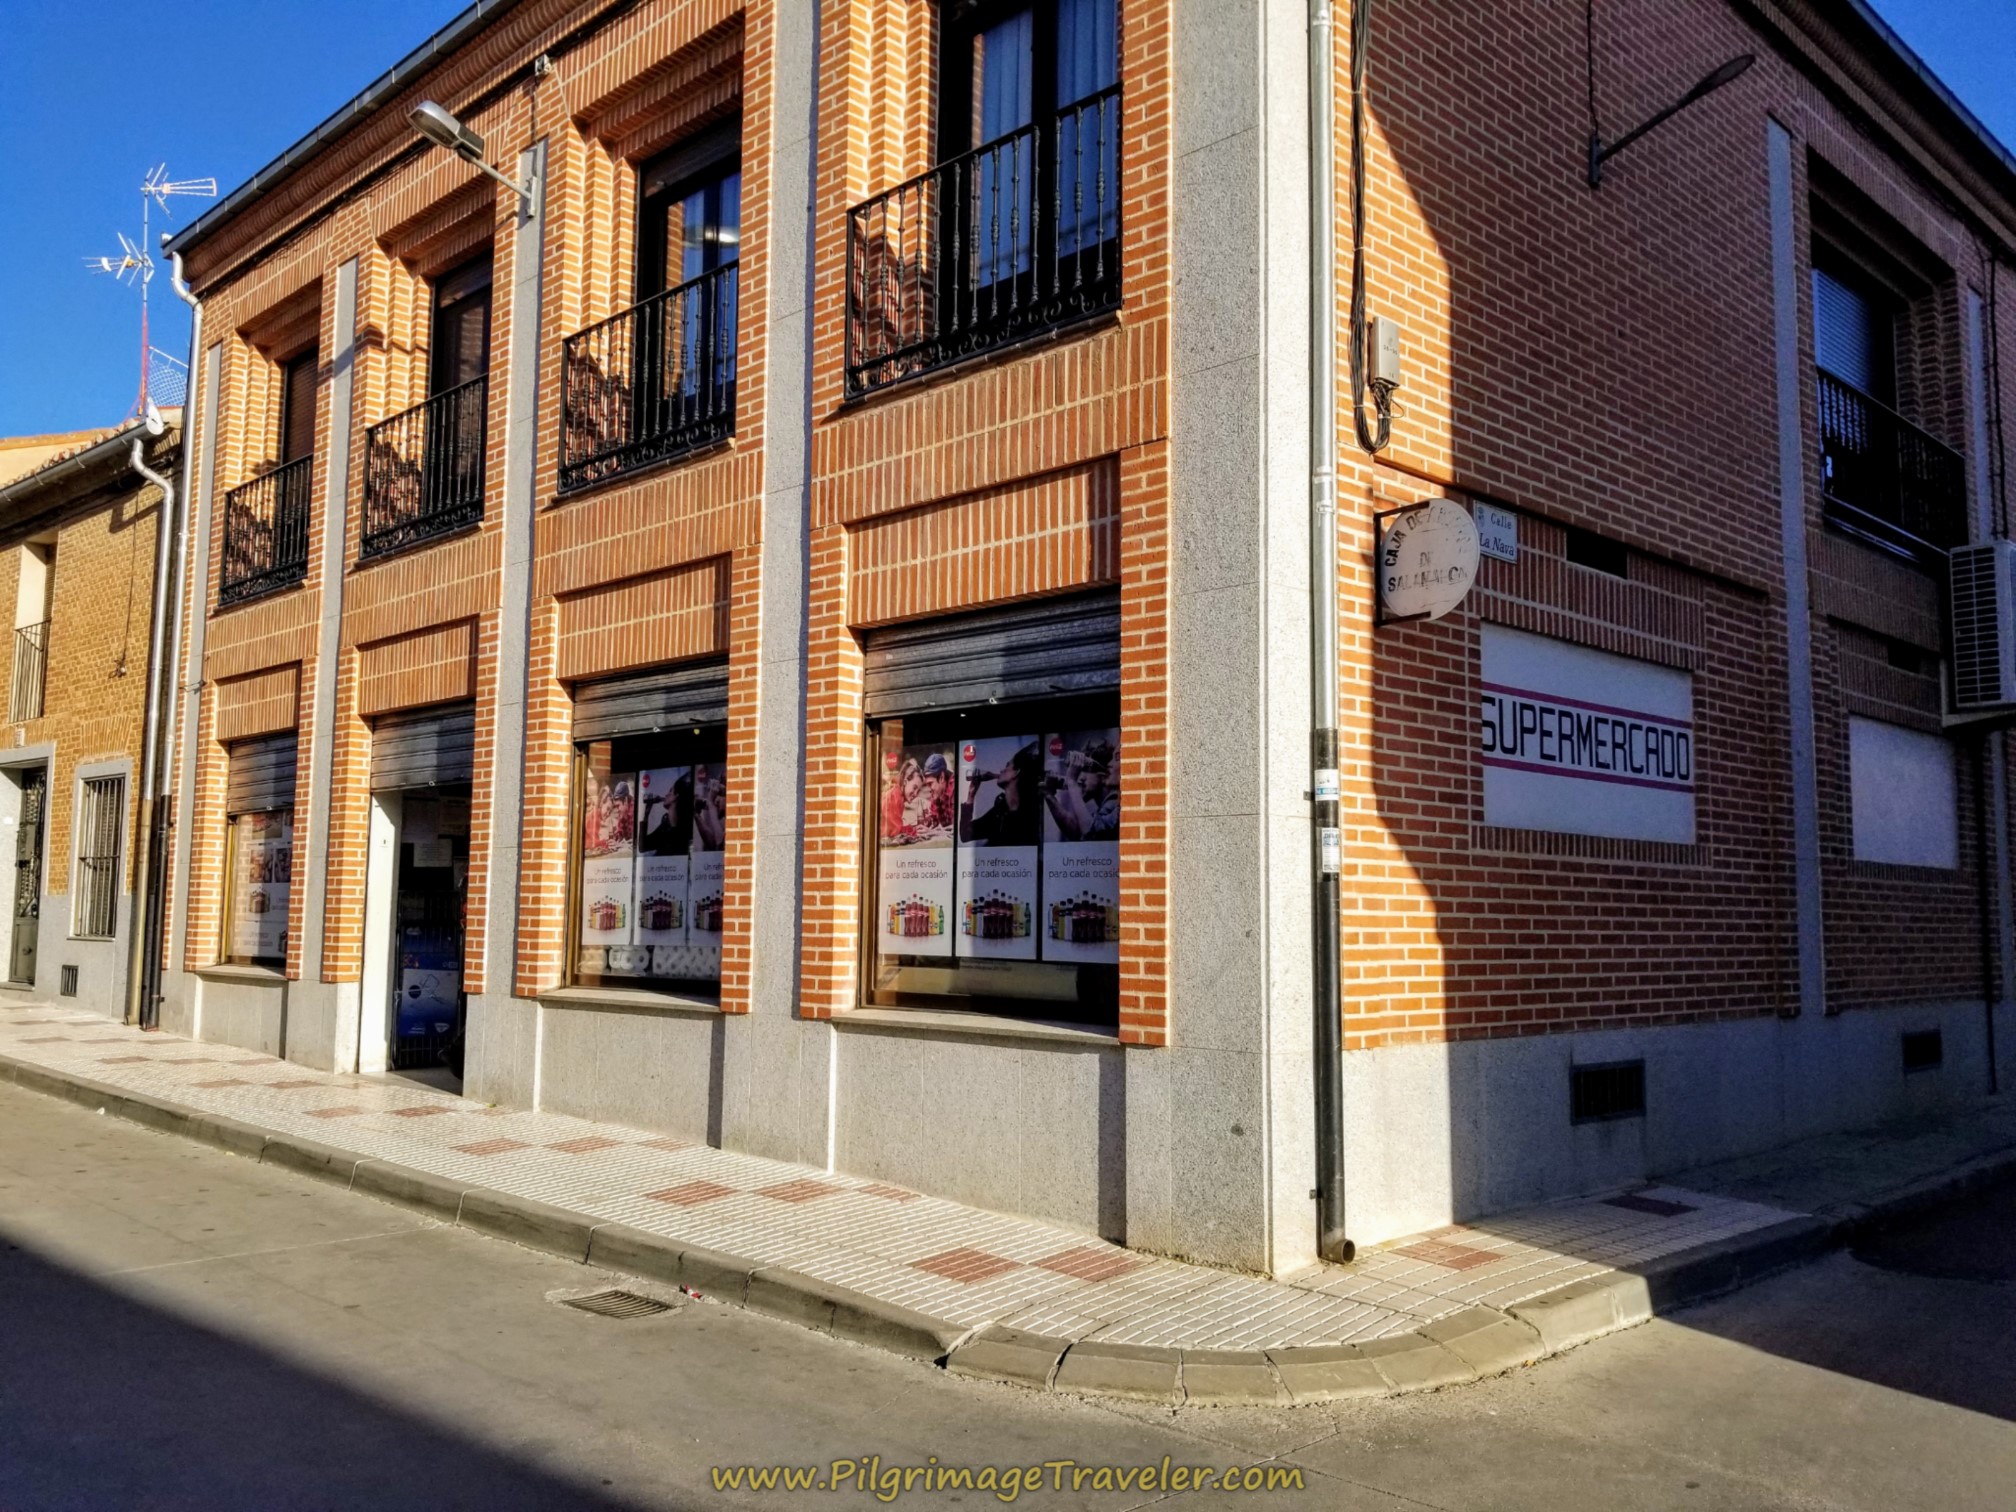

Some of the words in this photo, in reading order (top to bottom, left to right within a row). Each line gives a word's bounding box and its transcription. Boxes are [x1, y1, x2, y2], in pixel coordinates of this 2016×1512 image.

[1490, 513, 1512, 530] Calle
[1385, 529, 1407, 567] CAJA
[1480, 533, 1490, 549] La
[1492, 537, 1514, 556] Nava
[1481, 696, 1691, 781] SUPERMERCADO
[895, 859, 906, 869] Un
[907, 859, 937, 868] refresco
[974, 858, 985, 867] Un
[987, 857, 1020, 867] refresco
[1062, 856, 1075, 867] Un
[1076, 856, 1112, 867] refresco
[902, 870, 919, 879] cada
[920, 869, 948, 879] ocasión
[962, 870, 979, 879] para
[980, 869, 999, 878] cada
[1001, 868, 1033, 878] ocasión
[1048, 870, 1068, 879] para
[1069, 868, 1090, 878] cada
